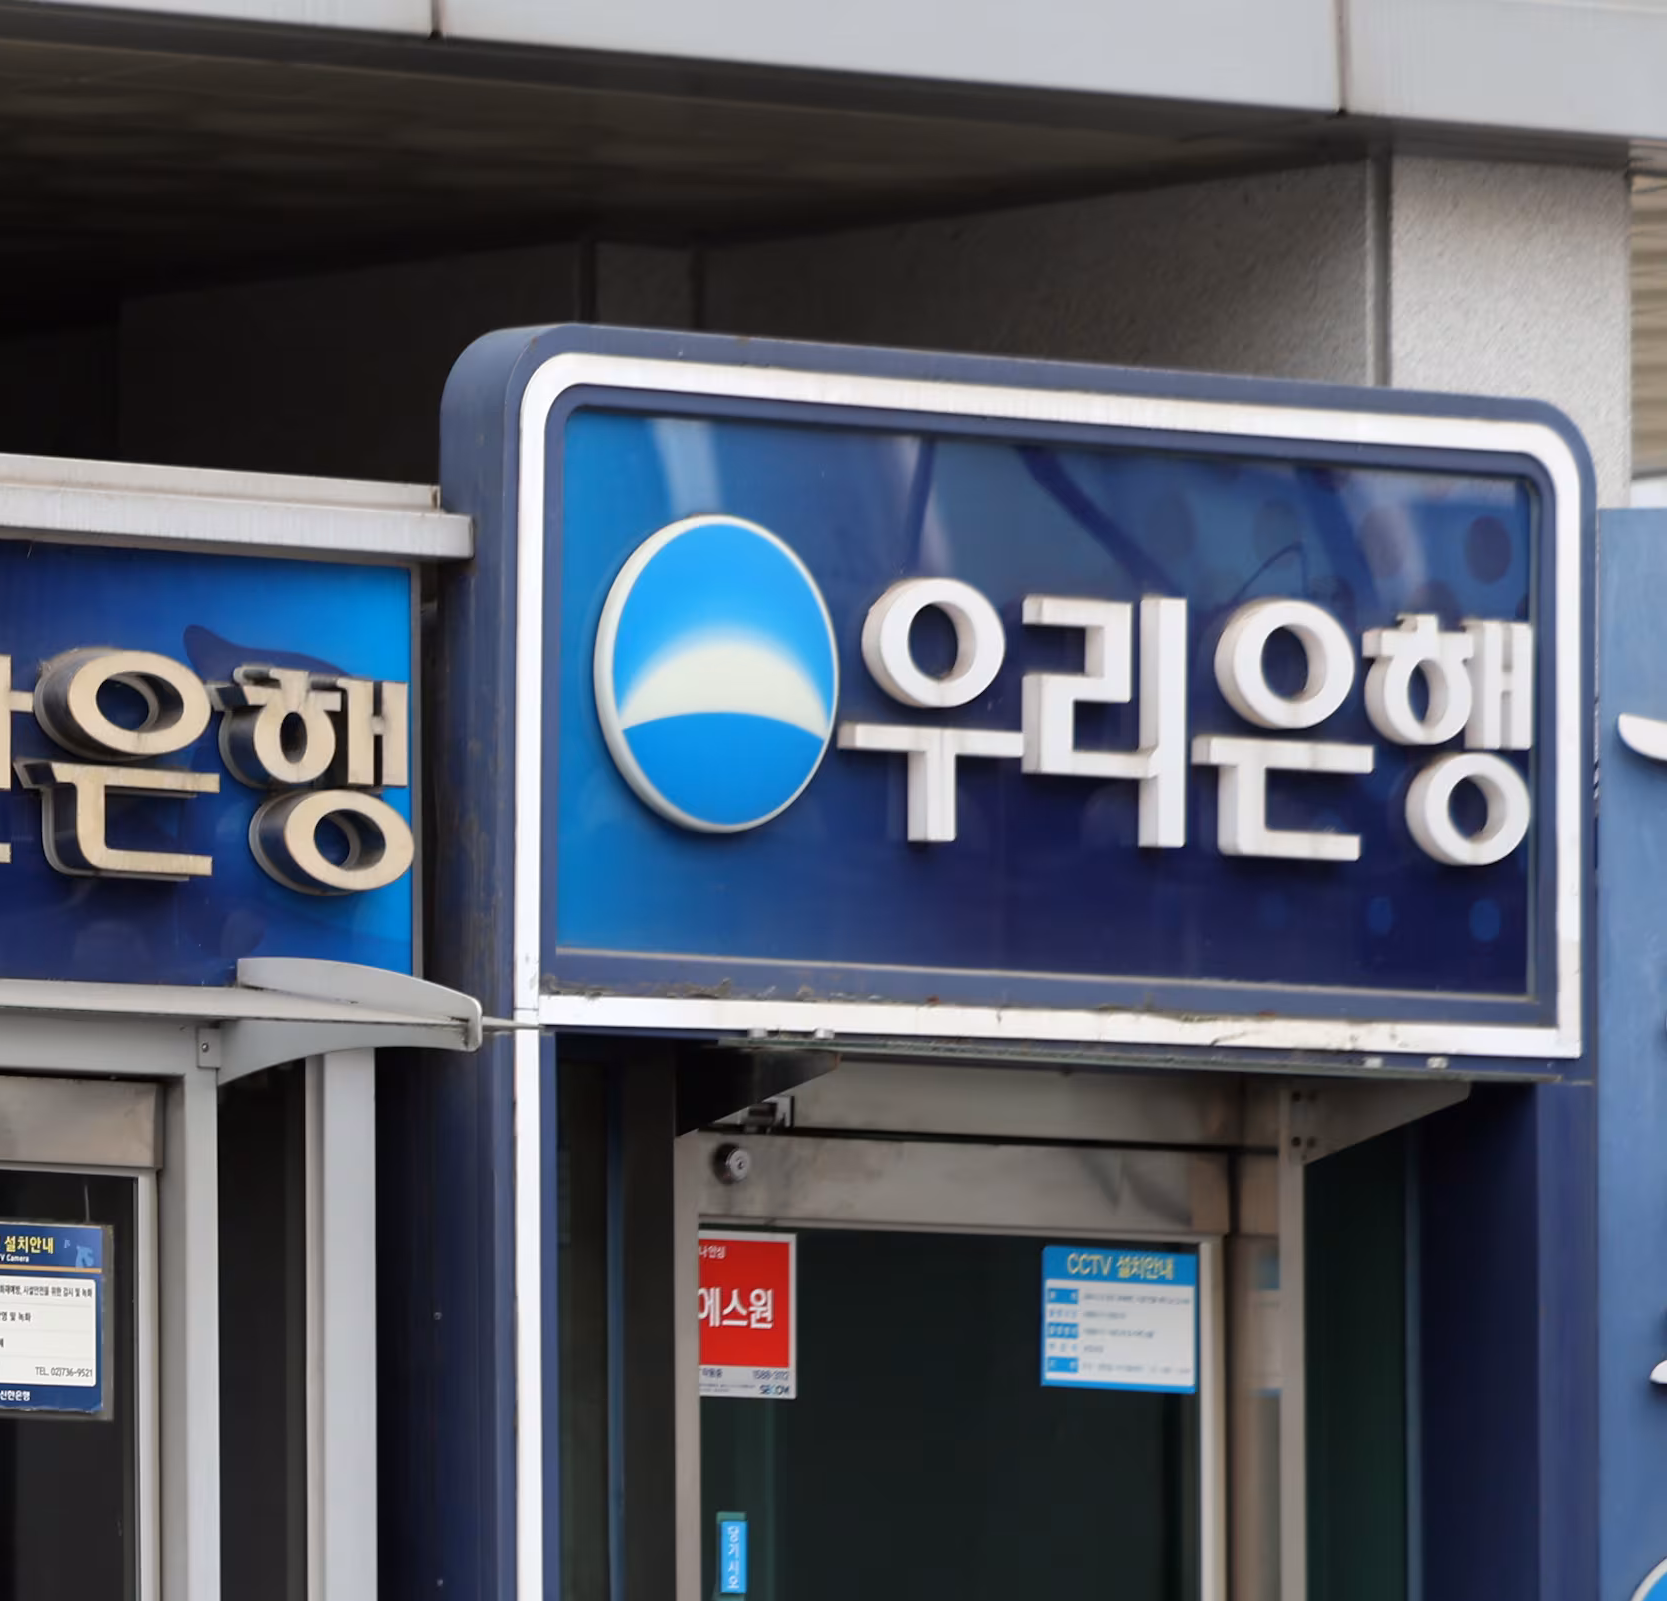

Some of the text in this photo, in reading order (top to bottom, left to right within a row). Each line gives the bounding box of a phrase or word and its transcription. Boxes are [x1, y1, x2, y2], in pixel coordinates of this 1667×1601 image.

[837, 576, 1534, 868] 우리은행
[4, 1235, 54, 1254] 설치안내
[698, 1286, 774, 1329] 에스원
